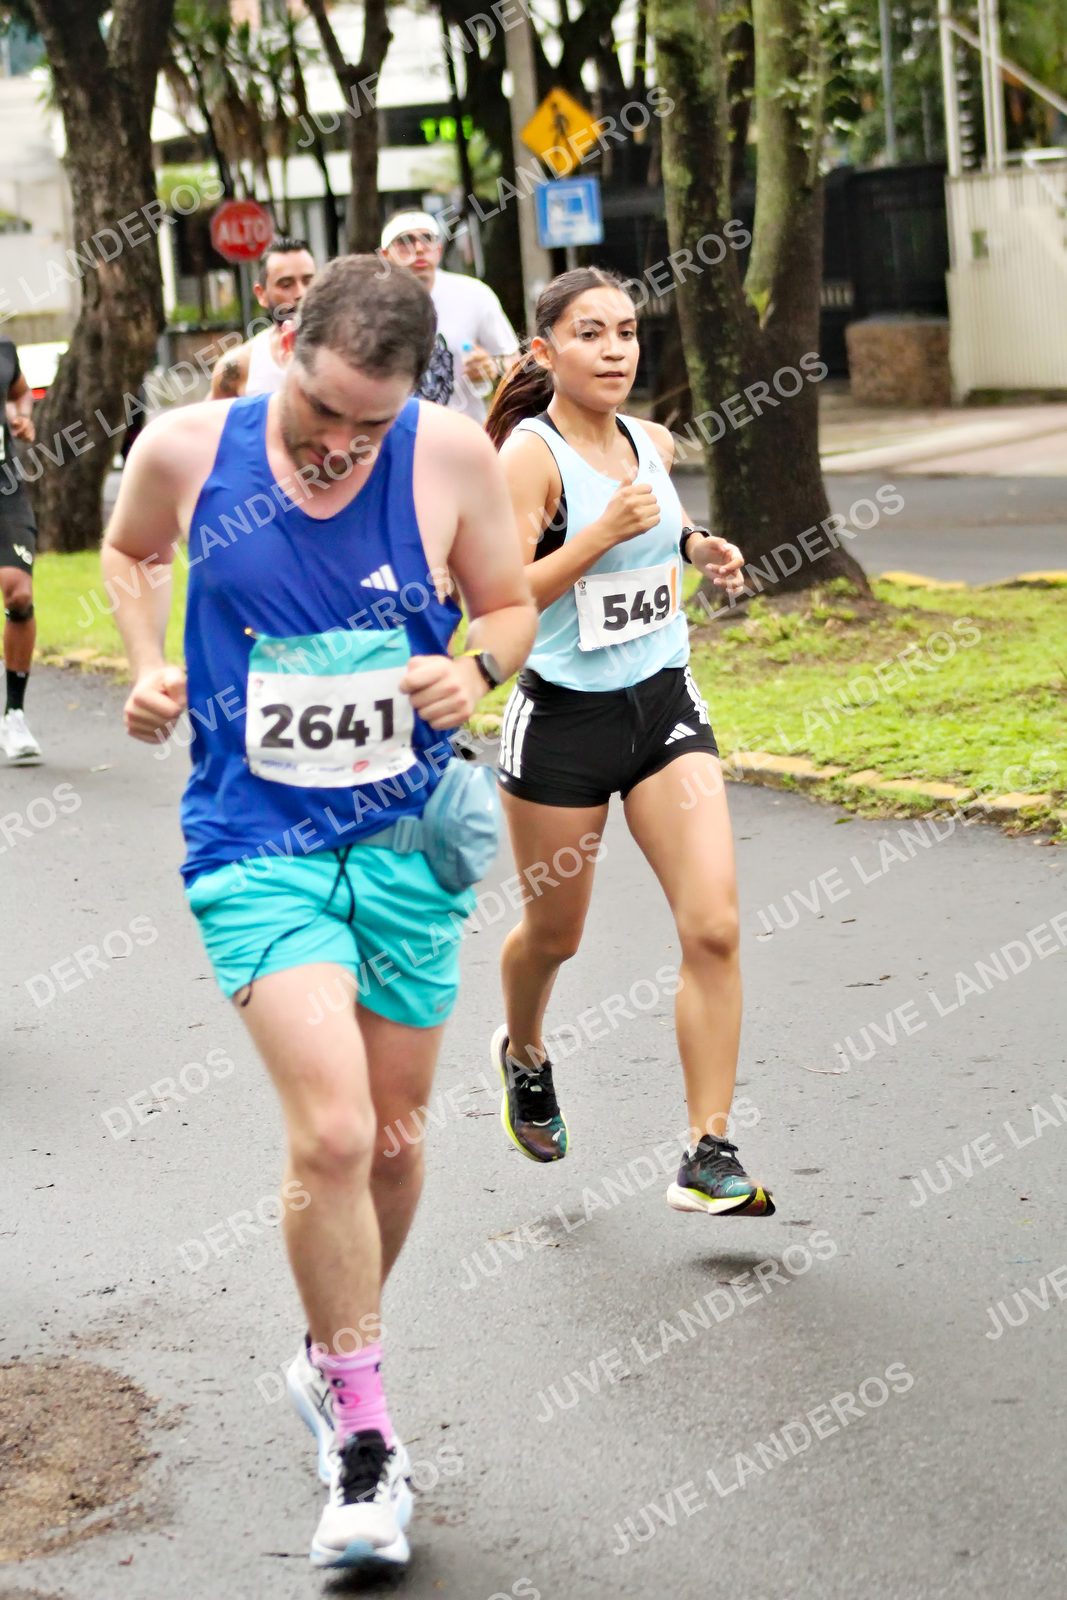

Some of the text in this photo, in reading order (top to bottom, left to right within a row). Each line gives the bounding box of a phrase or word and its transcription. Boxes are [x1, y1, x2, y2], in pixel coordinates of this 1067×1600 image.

[217, 217, 268, 245] ALTO
[603, 584, 671, 631] 549
[259, 698, 395, 750] 2641
